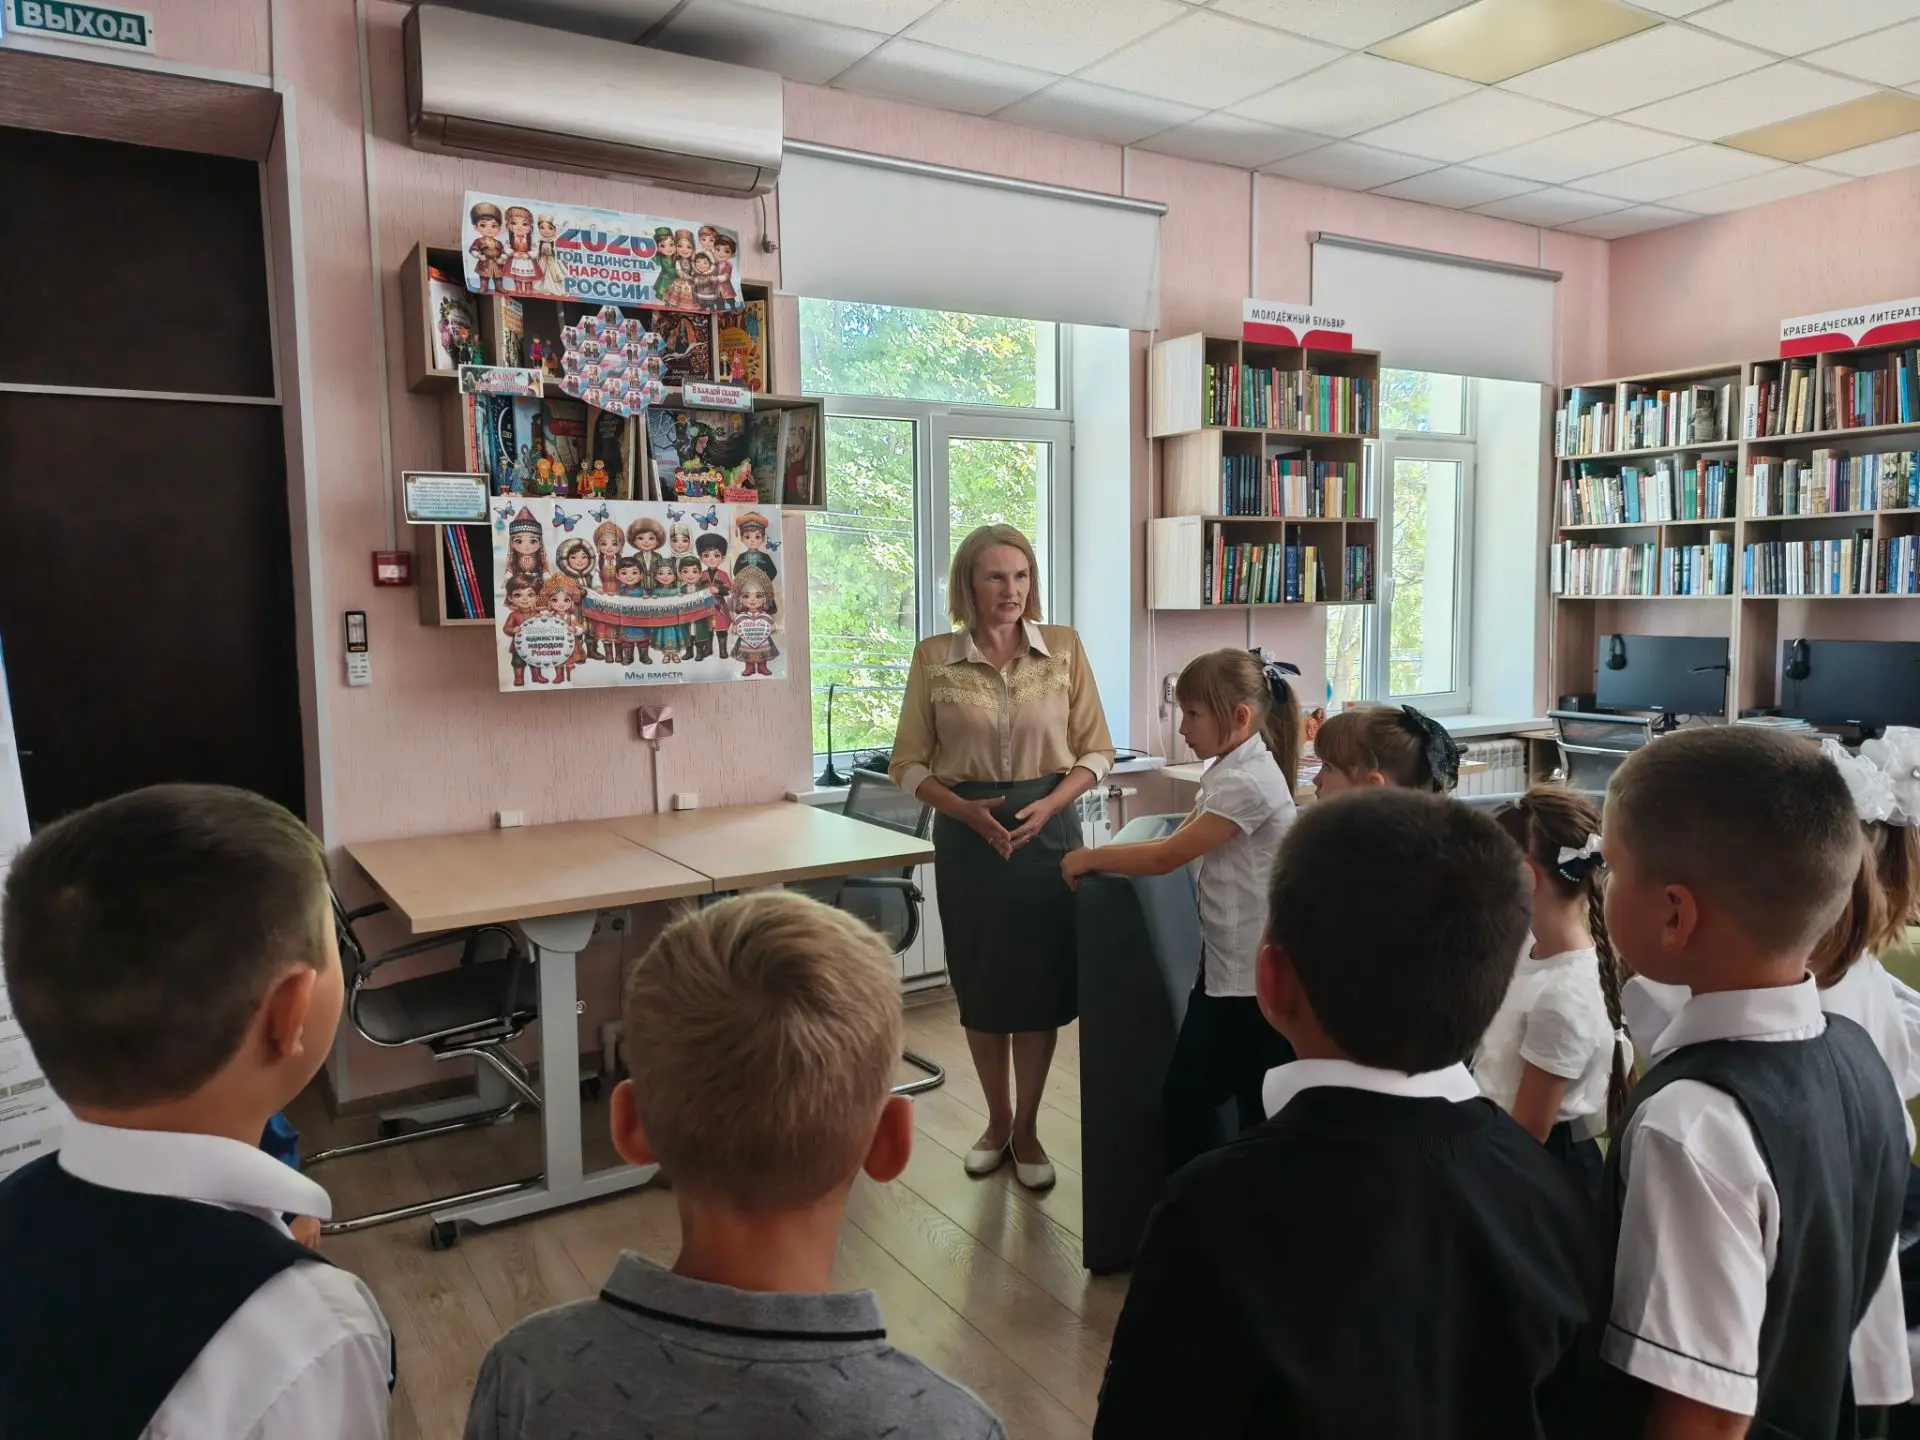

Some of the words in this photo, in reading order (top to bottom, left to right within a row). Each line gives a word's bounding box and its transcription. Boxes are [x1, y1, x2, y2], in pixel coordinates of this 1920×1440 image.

[21, 1, 142, 43] ВЫХОД
[555, 217, 657, 258] 2026
[556, 250, 583, 265] ГОД
[586, 253, 656, 271] ЕДИНСТВА
[569, 265, 642, 283] НАРОДОВ
[564, 277, 650, 300] РОССИИ
[1313, 316, 1346, 328] БУЛЬВАР
[1783, 315, 1865, 336] КРАЕВЕДЧЕСКАЯ
[528, 642, 564, 650] народов
[624, 671, 645, 680] Мы
[647, 671, 683, 679] вместе
